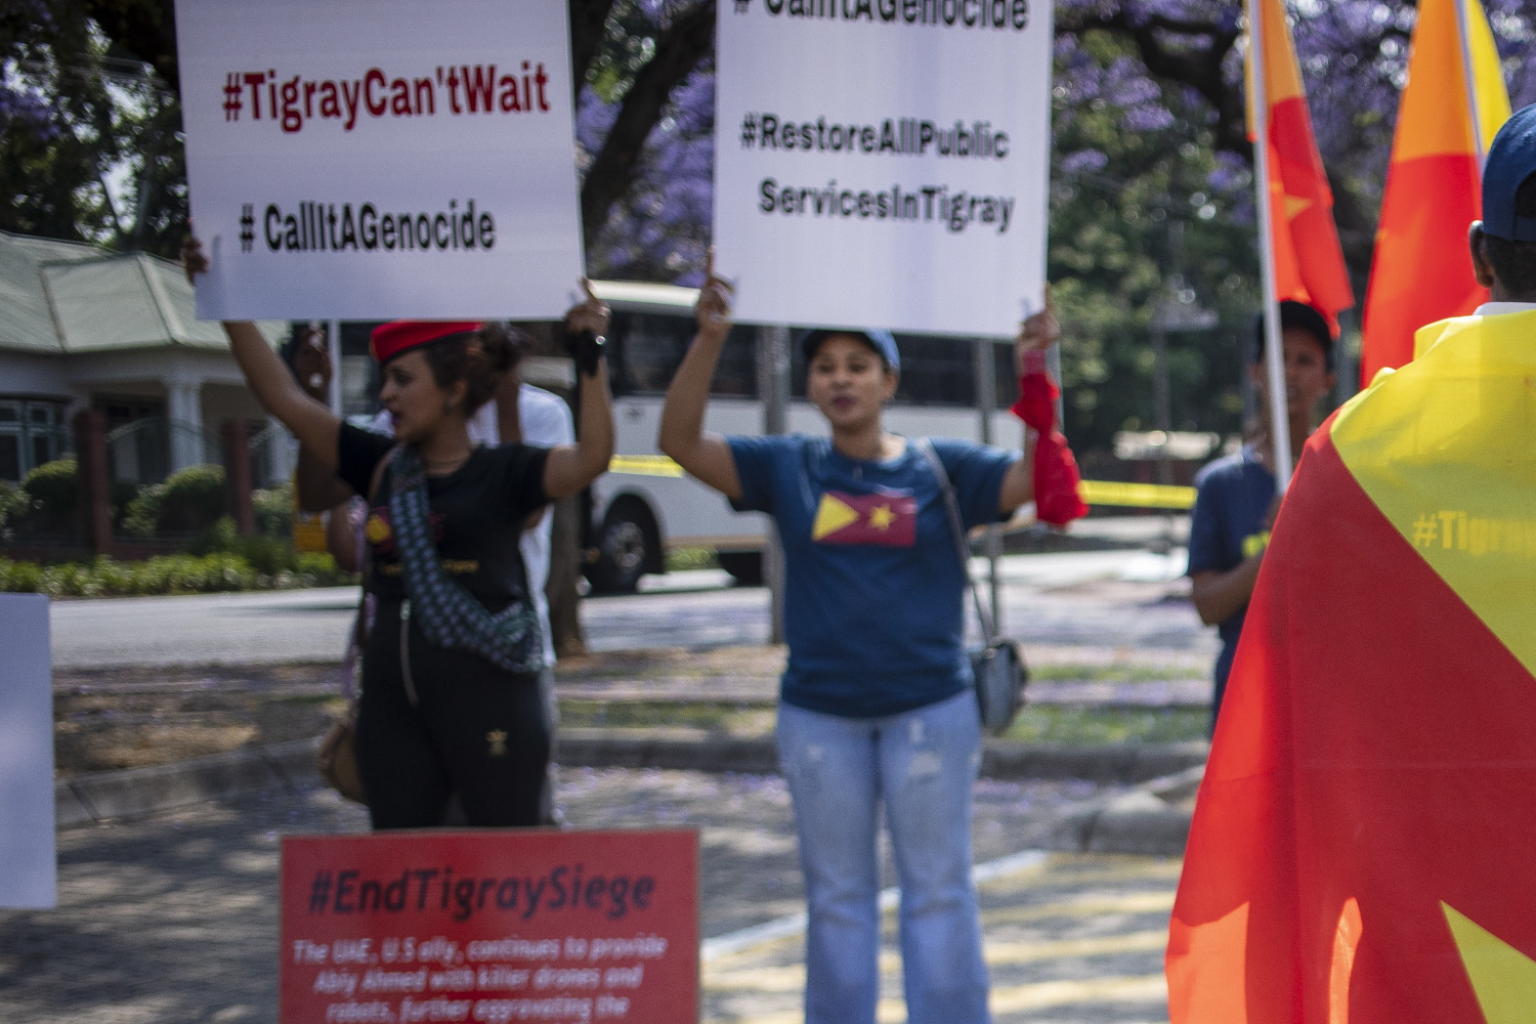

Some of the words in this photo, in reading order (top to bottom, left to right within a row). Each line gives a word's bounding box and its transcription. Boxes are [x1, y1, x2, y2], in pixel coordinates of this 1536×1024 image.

[223, 61, 550, 133] #TigrayCan'tWait
[740, 112, 1010, 159] #RestoreAllPublic
[760, 176, 1016, 235] ServicesInTigray
[307, 866, 656, 921] #EndTigraySiege
[294, 938, 330, 965] The
